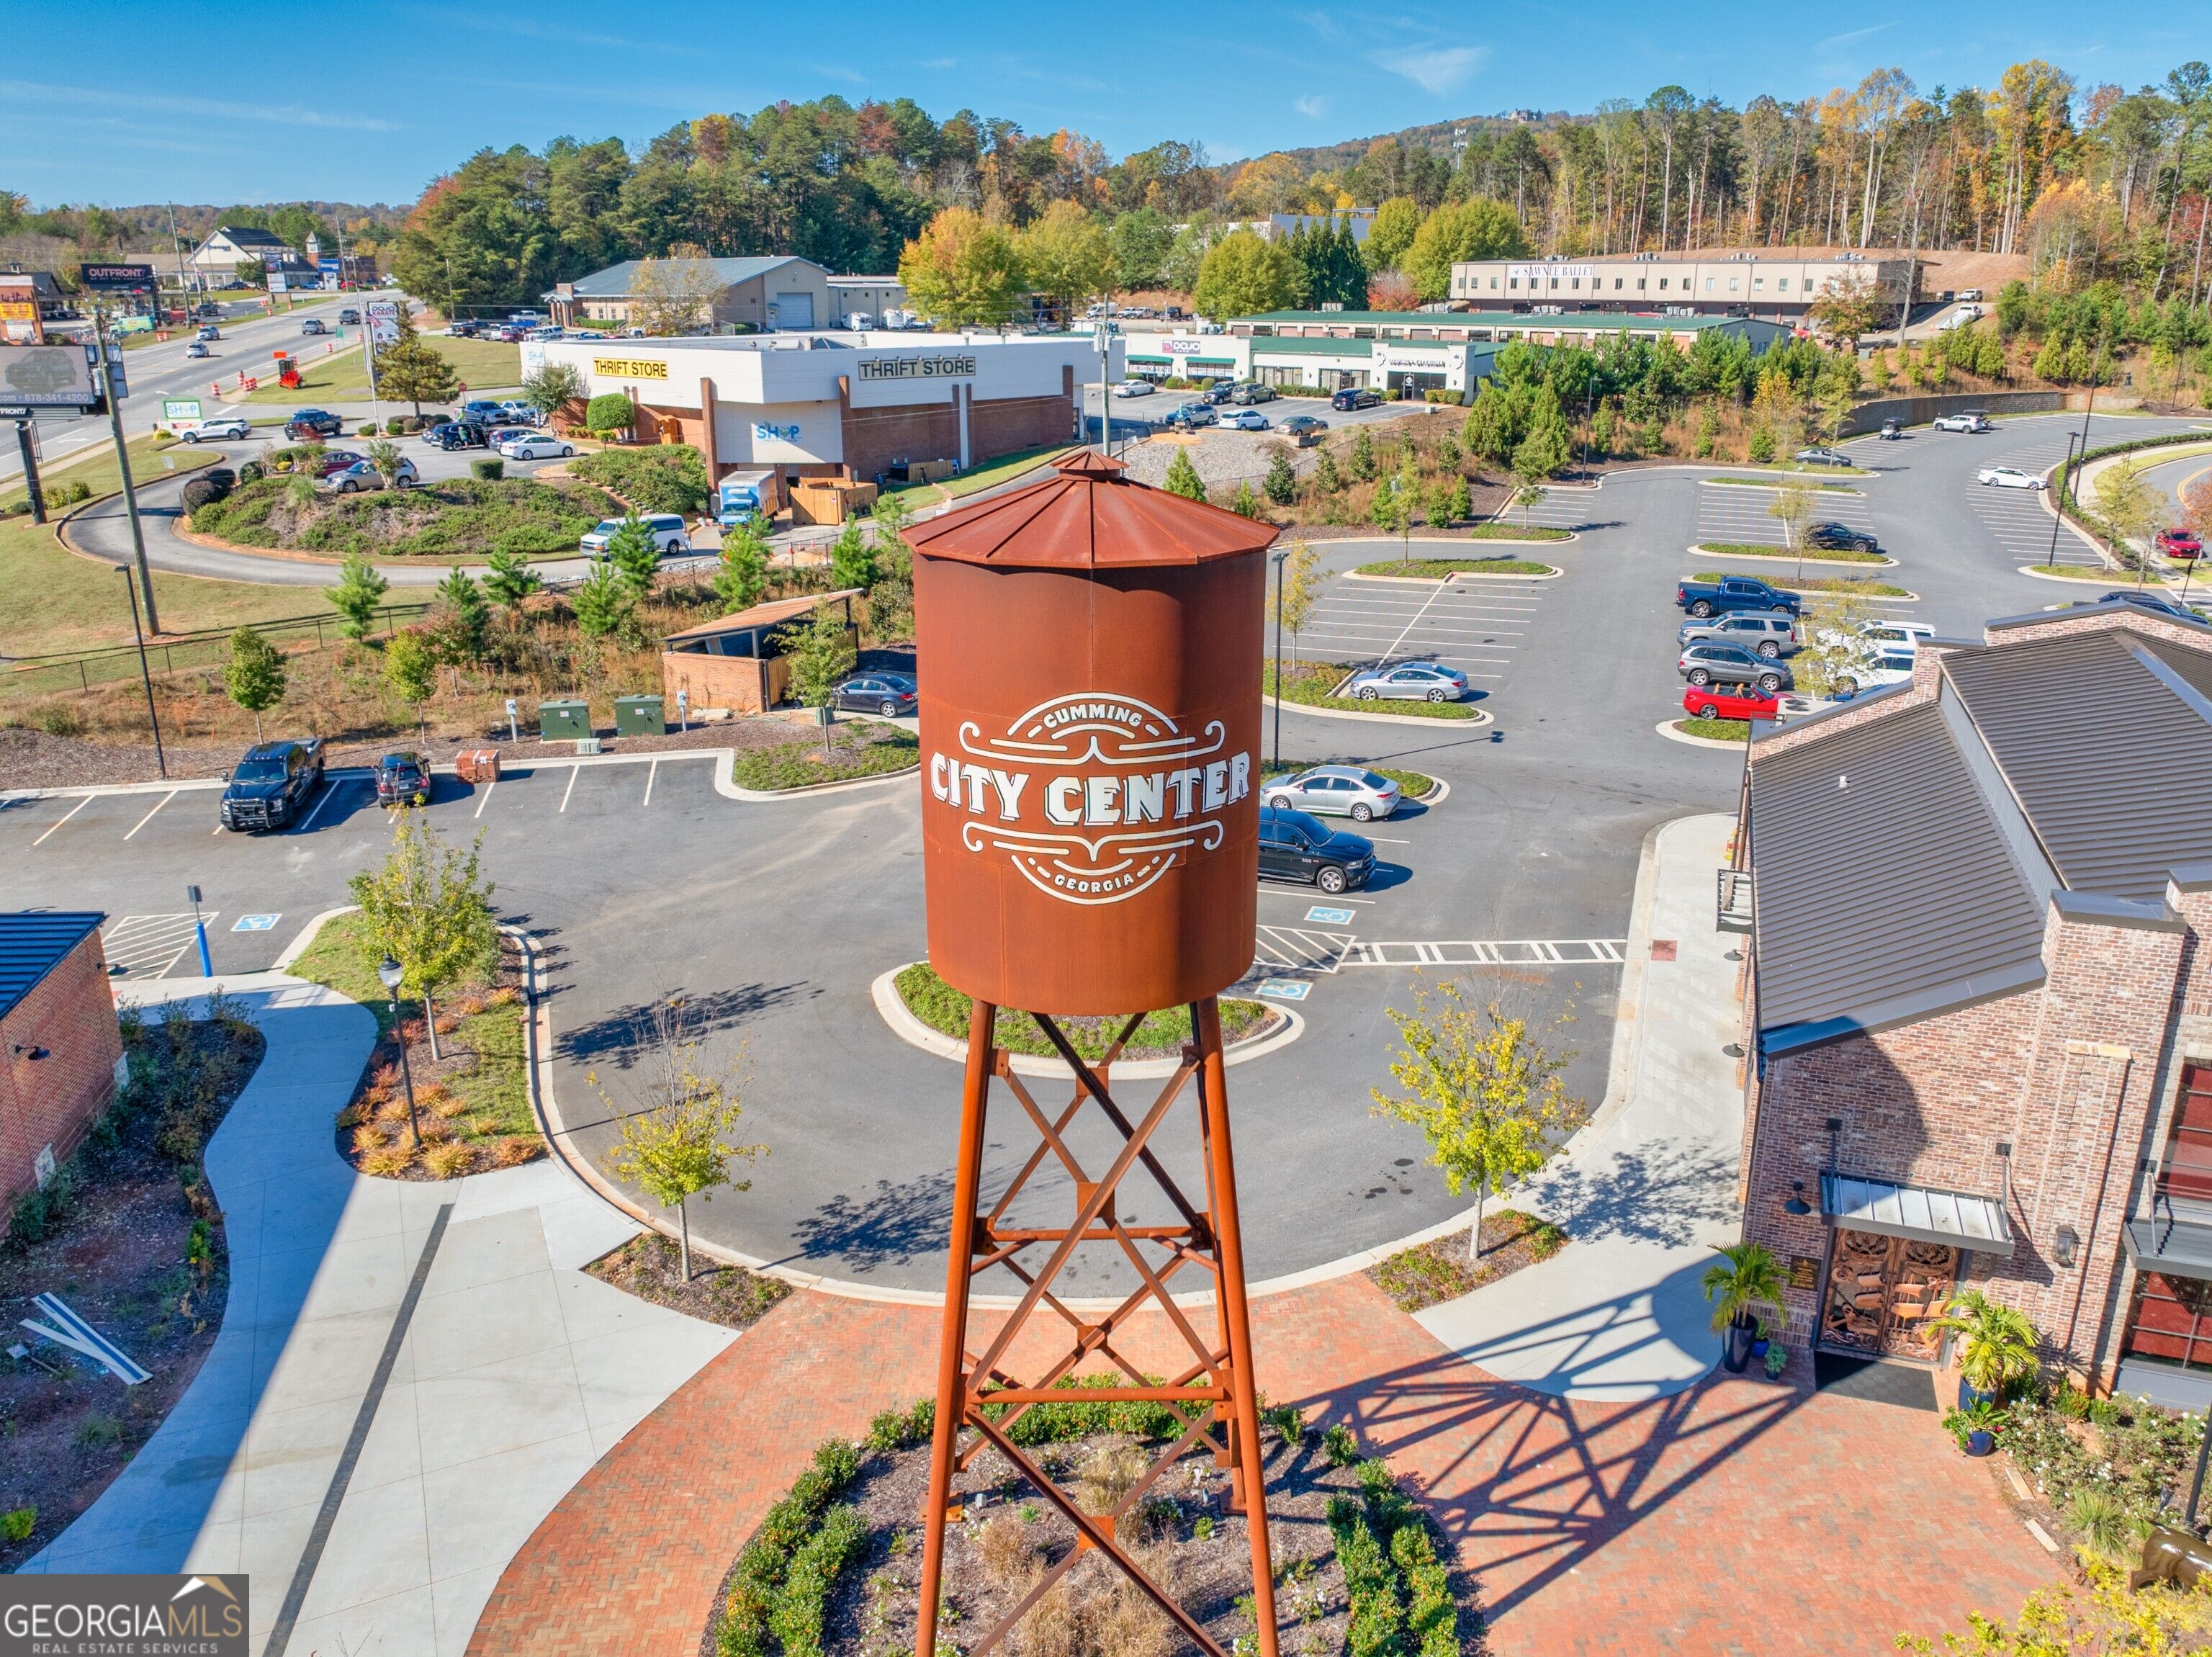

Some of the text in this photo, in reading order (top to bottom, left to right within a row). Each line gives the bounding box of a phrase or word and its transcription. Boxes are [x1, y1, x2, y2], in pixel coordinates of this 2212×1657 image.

[594, 360, 667, 377] THRIFT STORE
[860, 360, 974, 377] THRIFT STORE
[1043, 703, 1142, 729] CUMMING
[930, 750, 1250, 827] CITY CENTER
[1054, 873, 1135, 893] GEORGIA
